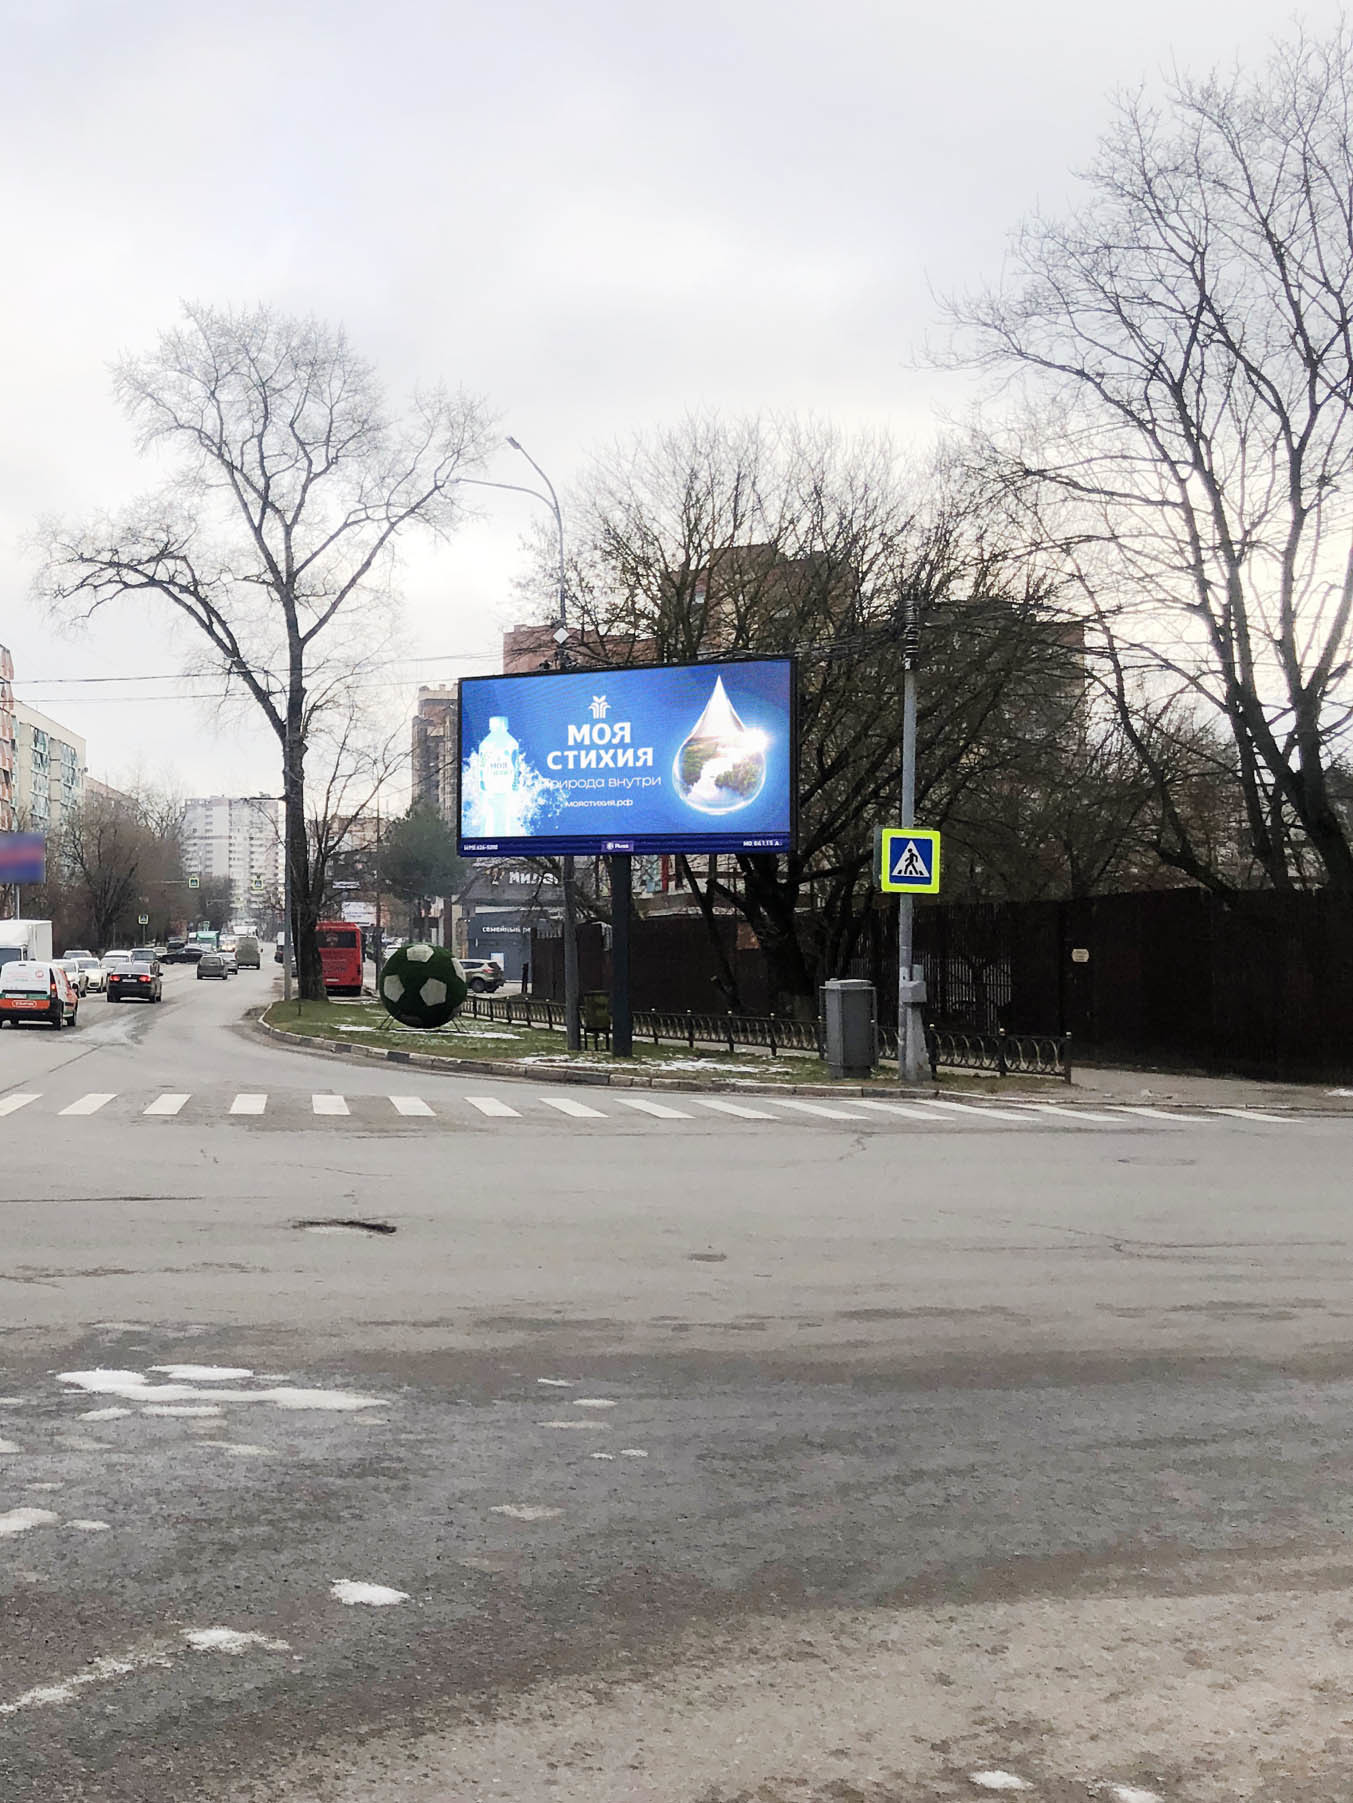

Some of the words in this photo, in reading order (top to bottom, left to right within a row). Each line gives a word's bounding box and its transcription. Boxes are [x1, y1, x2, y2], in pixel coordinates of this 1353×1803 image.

[567, 722, 631, 746] МОЯ
[546, 747, 654, 770] СТИХИЯ
[608, 776, 662, 789] внутри
